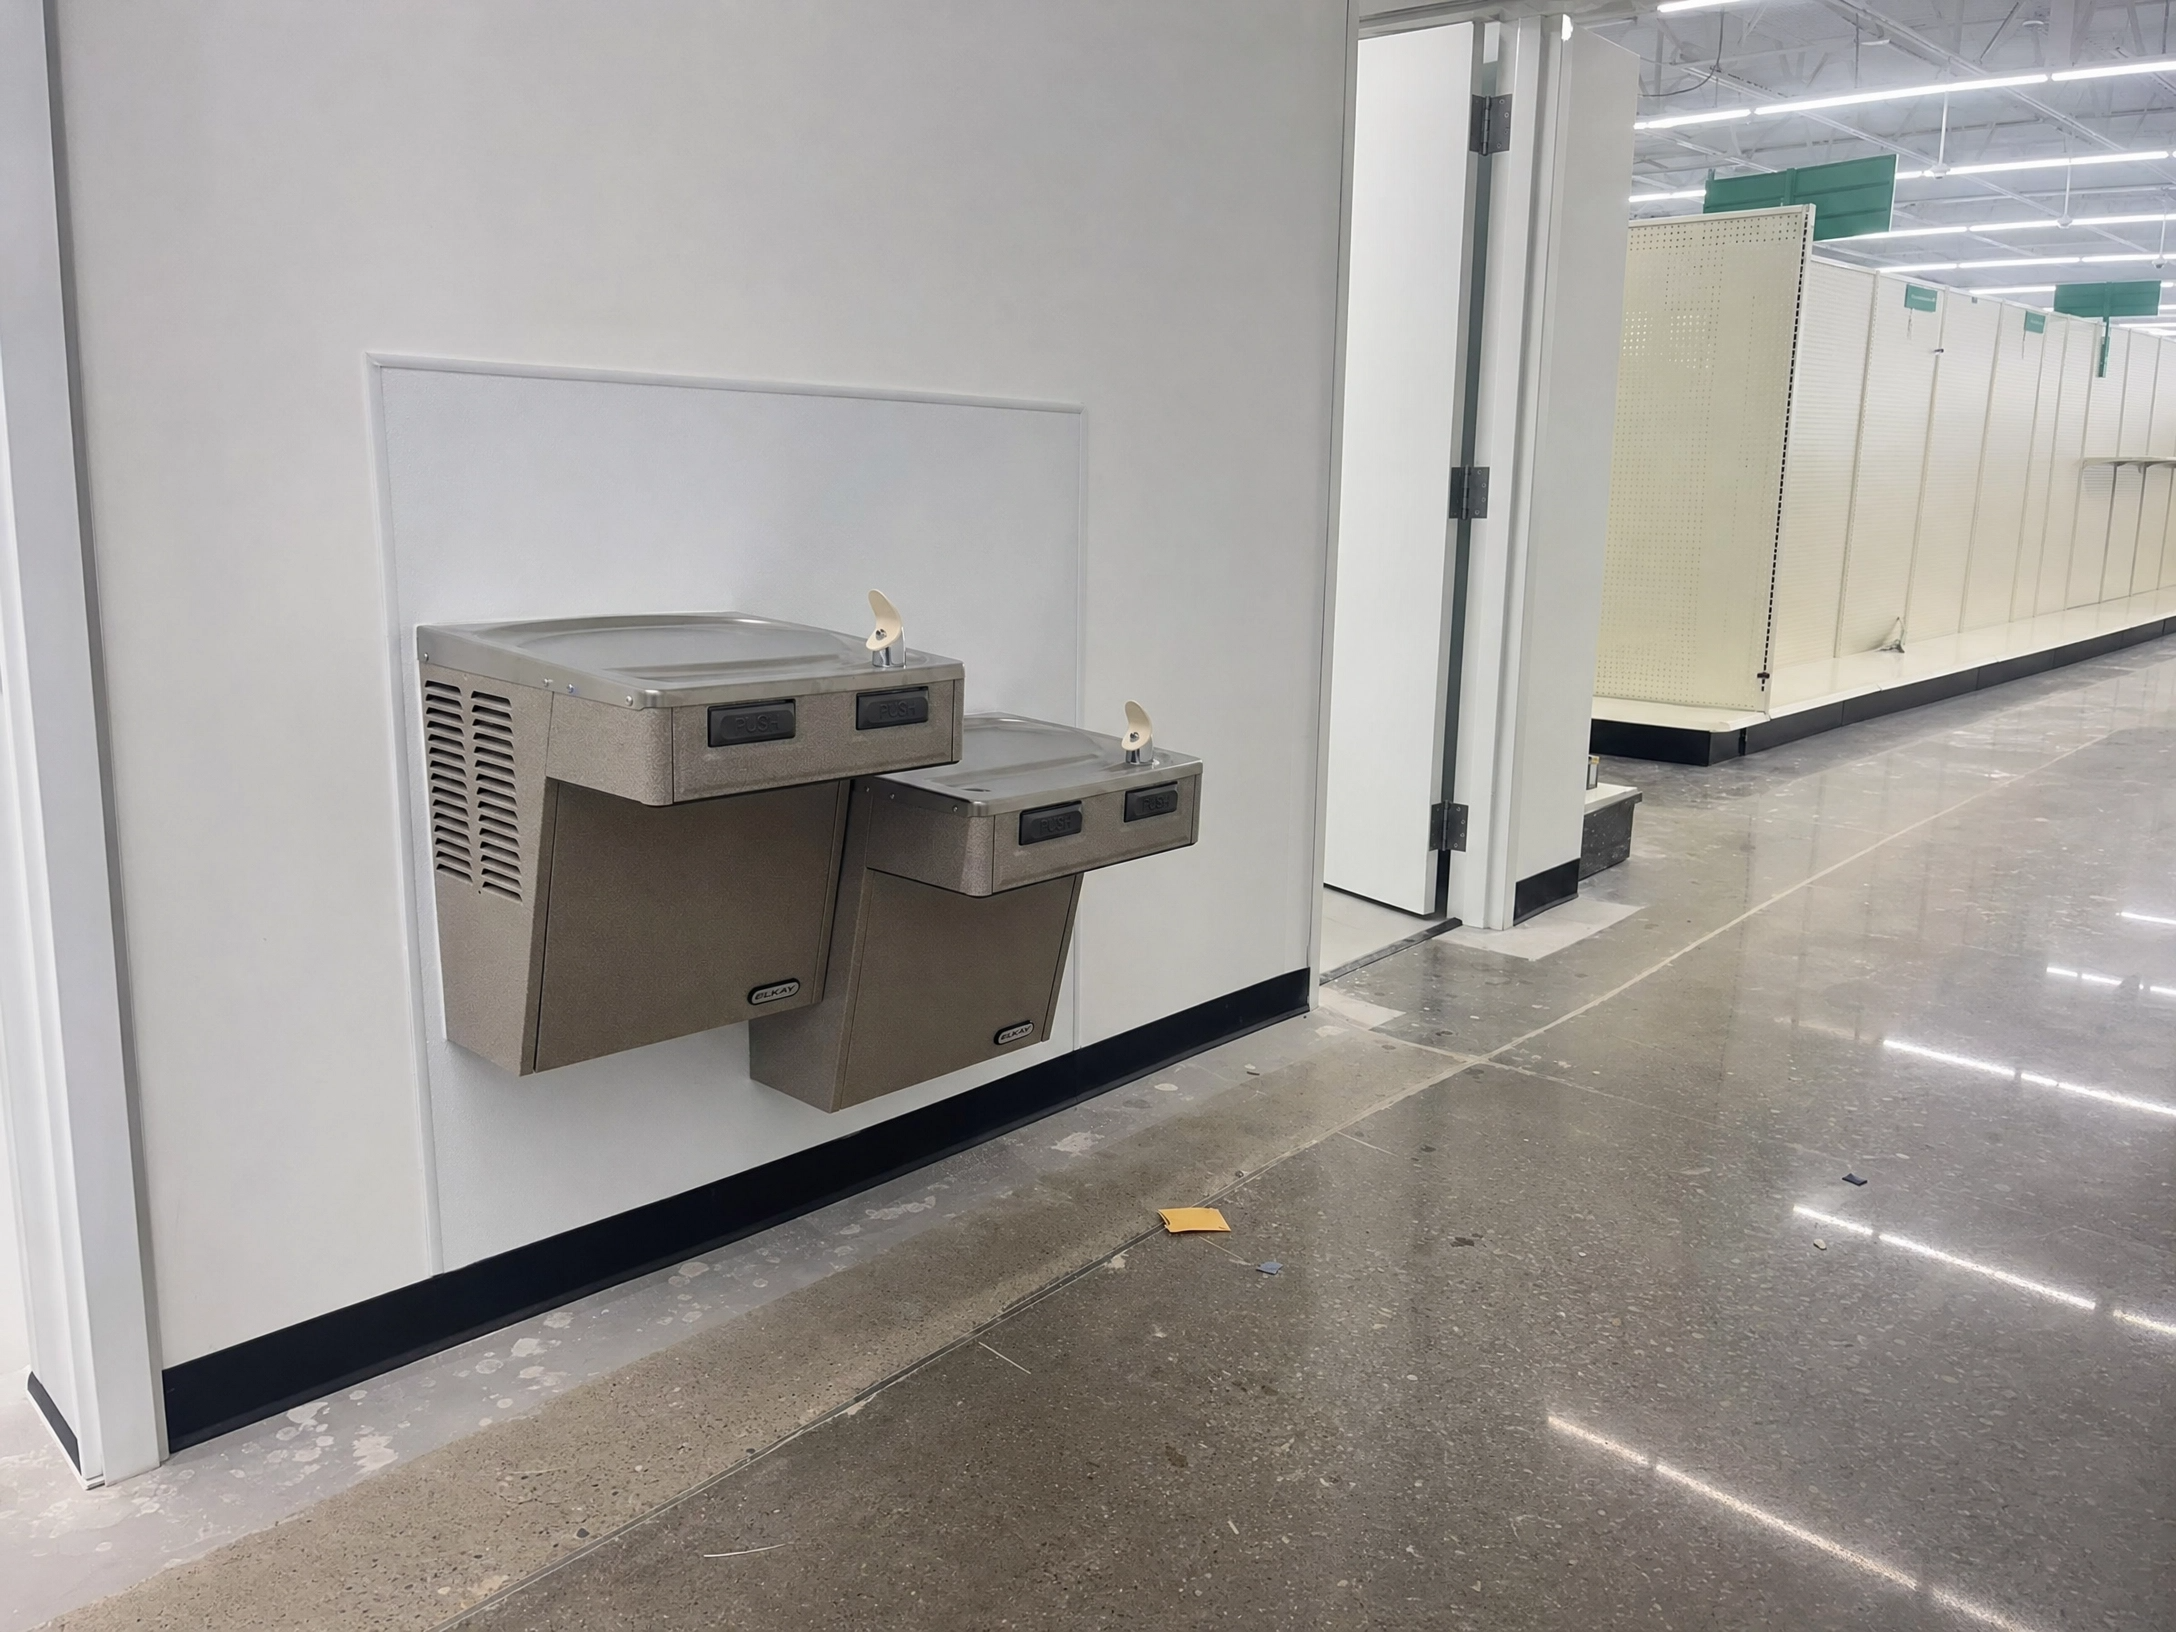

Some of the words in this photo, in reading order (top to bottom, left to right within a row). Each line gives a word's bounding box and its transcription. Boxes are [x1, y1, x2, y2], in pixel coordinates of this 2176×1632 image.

[879, 699, 917, 720] PUSH
[735, 713, 780, 734] PUSH
[1143, 795, 1170, 811] PUSH
[1041, 815, 1072, 834] PUSH
[754, 984, 796, 1000] ELKAY
[1000, 1025, 1032, 1040] ELKAY
